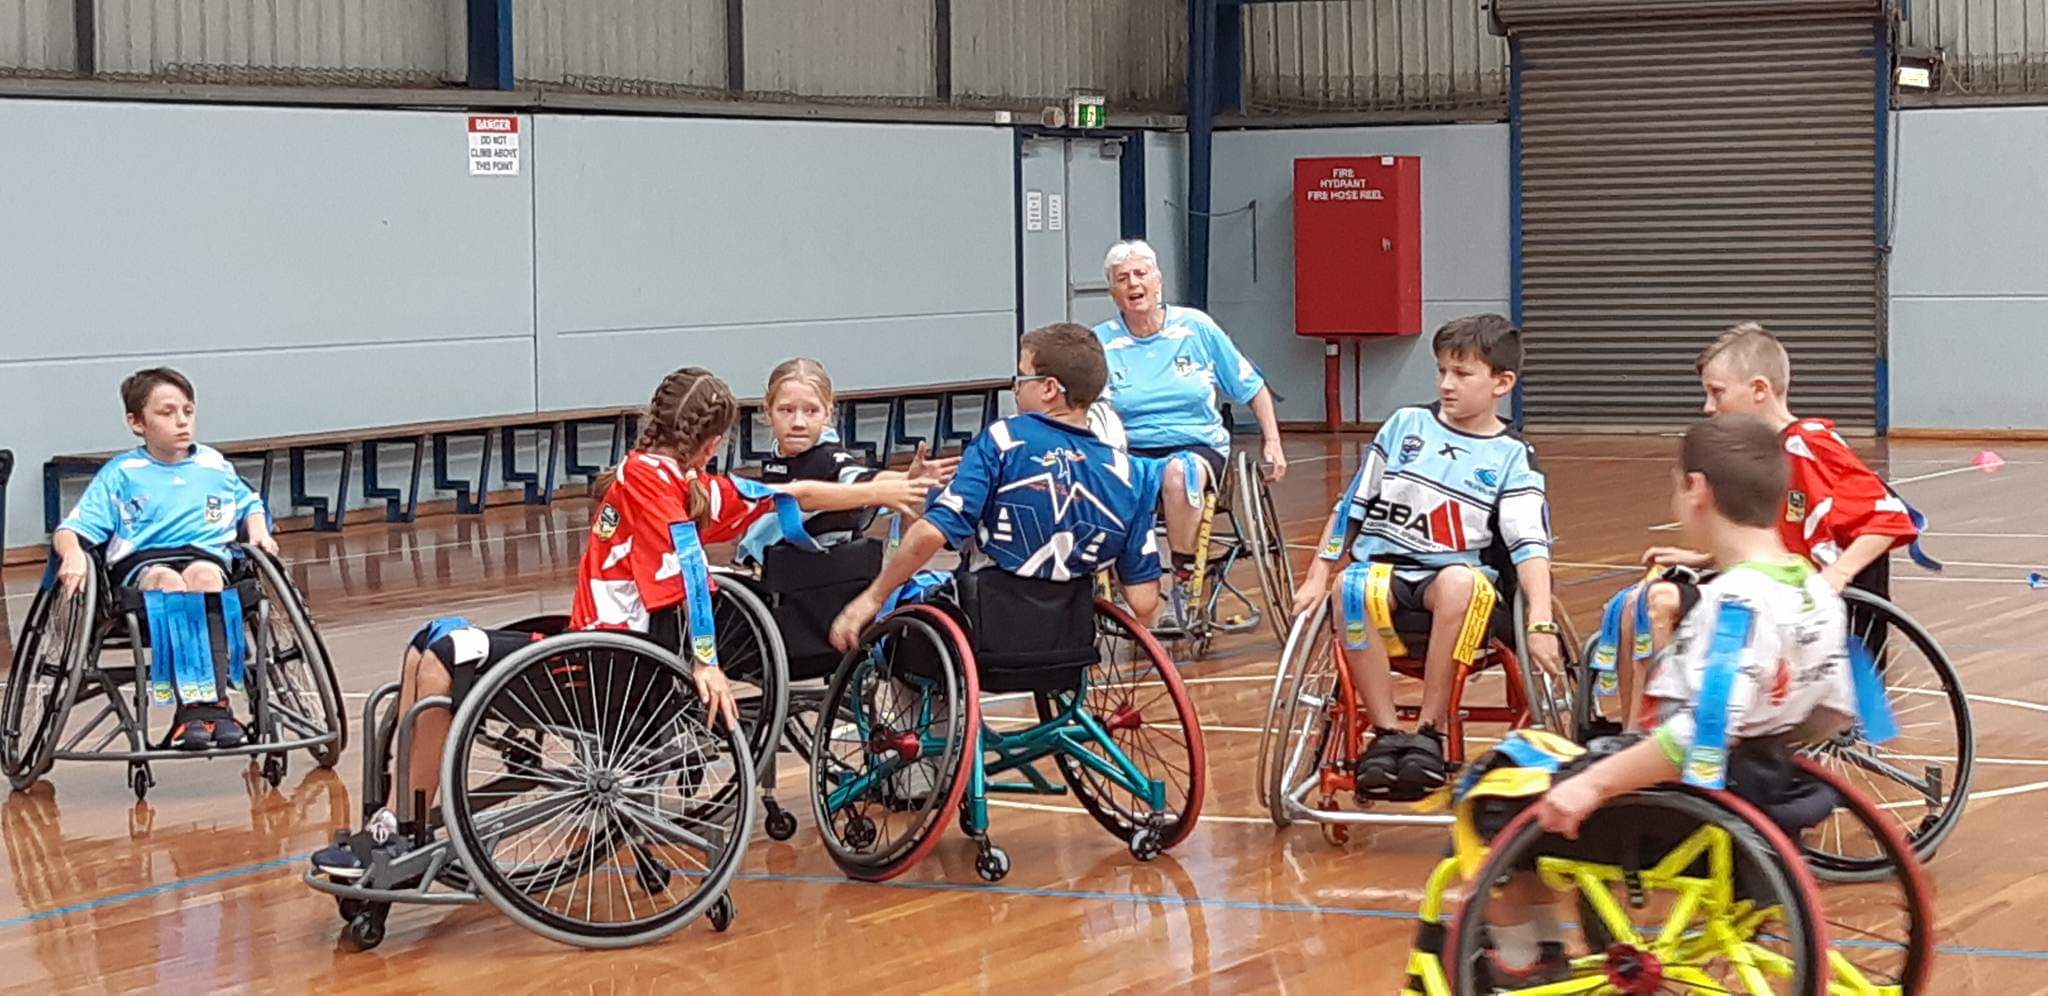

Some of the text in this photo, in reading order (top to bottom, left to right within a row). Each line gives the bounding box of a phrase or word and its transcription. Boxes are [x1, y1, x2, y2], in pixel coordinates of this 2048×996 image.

[475, 119, 511, 130] DANGER
[480, 136, 507, 145] DO NOT
[471, 149, 517, 158] CLIMB ABOVE
[475, 161, 513, 171] THIS POINT
[1333, 168, 1354, 178] FIRE
[1320, 179, 1366, 188] HYDRANT
[1308, 190, 1384, 200] FIRE HOSE REEL
[1367, 501, 1430, 540] SBA
